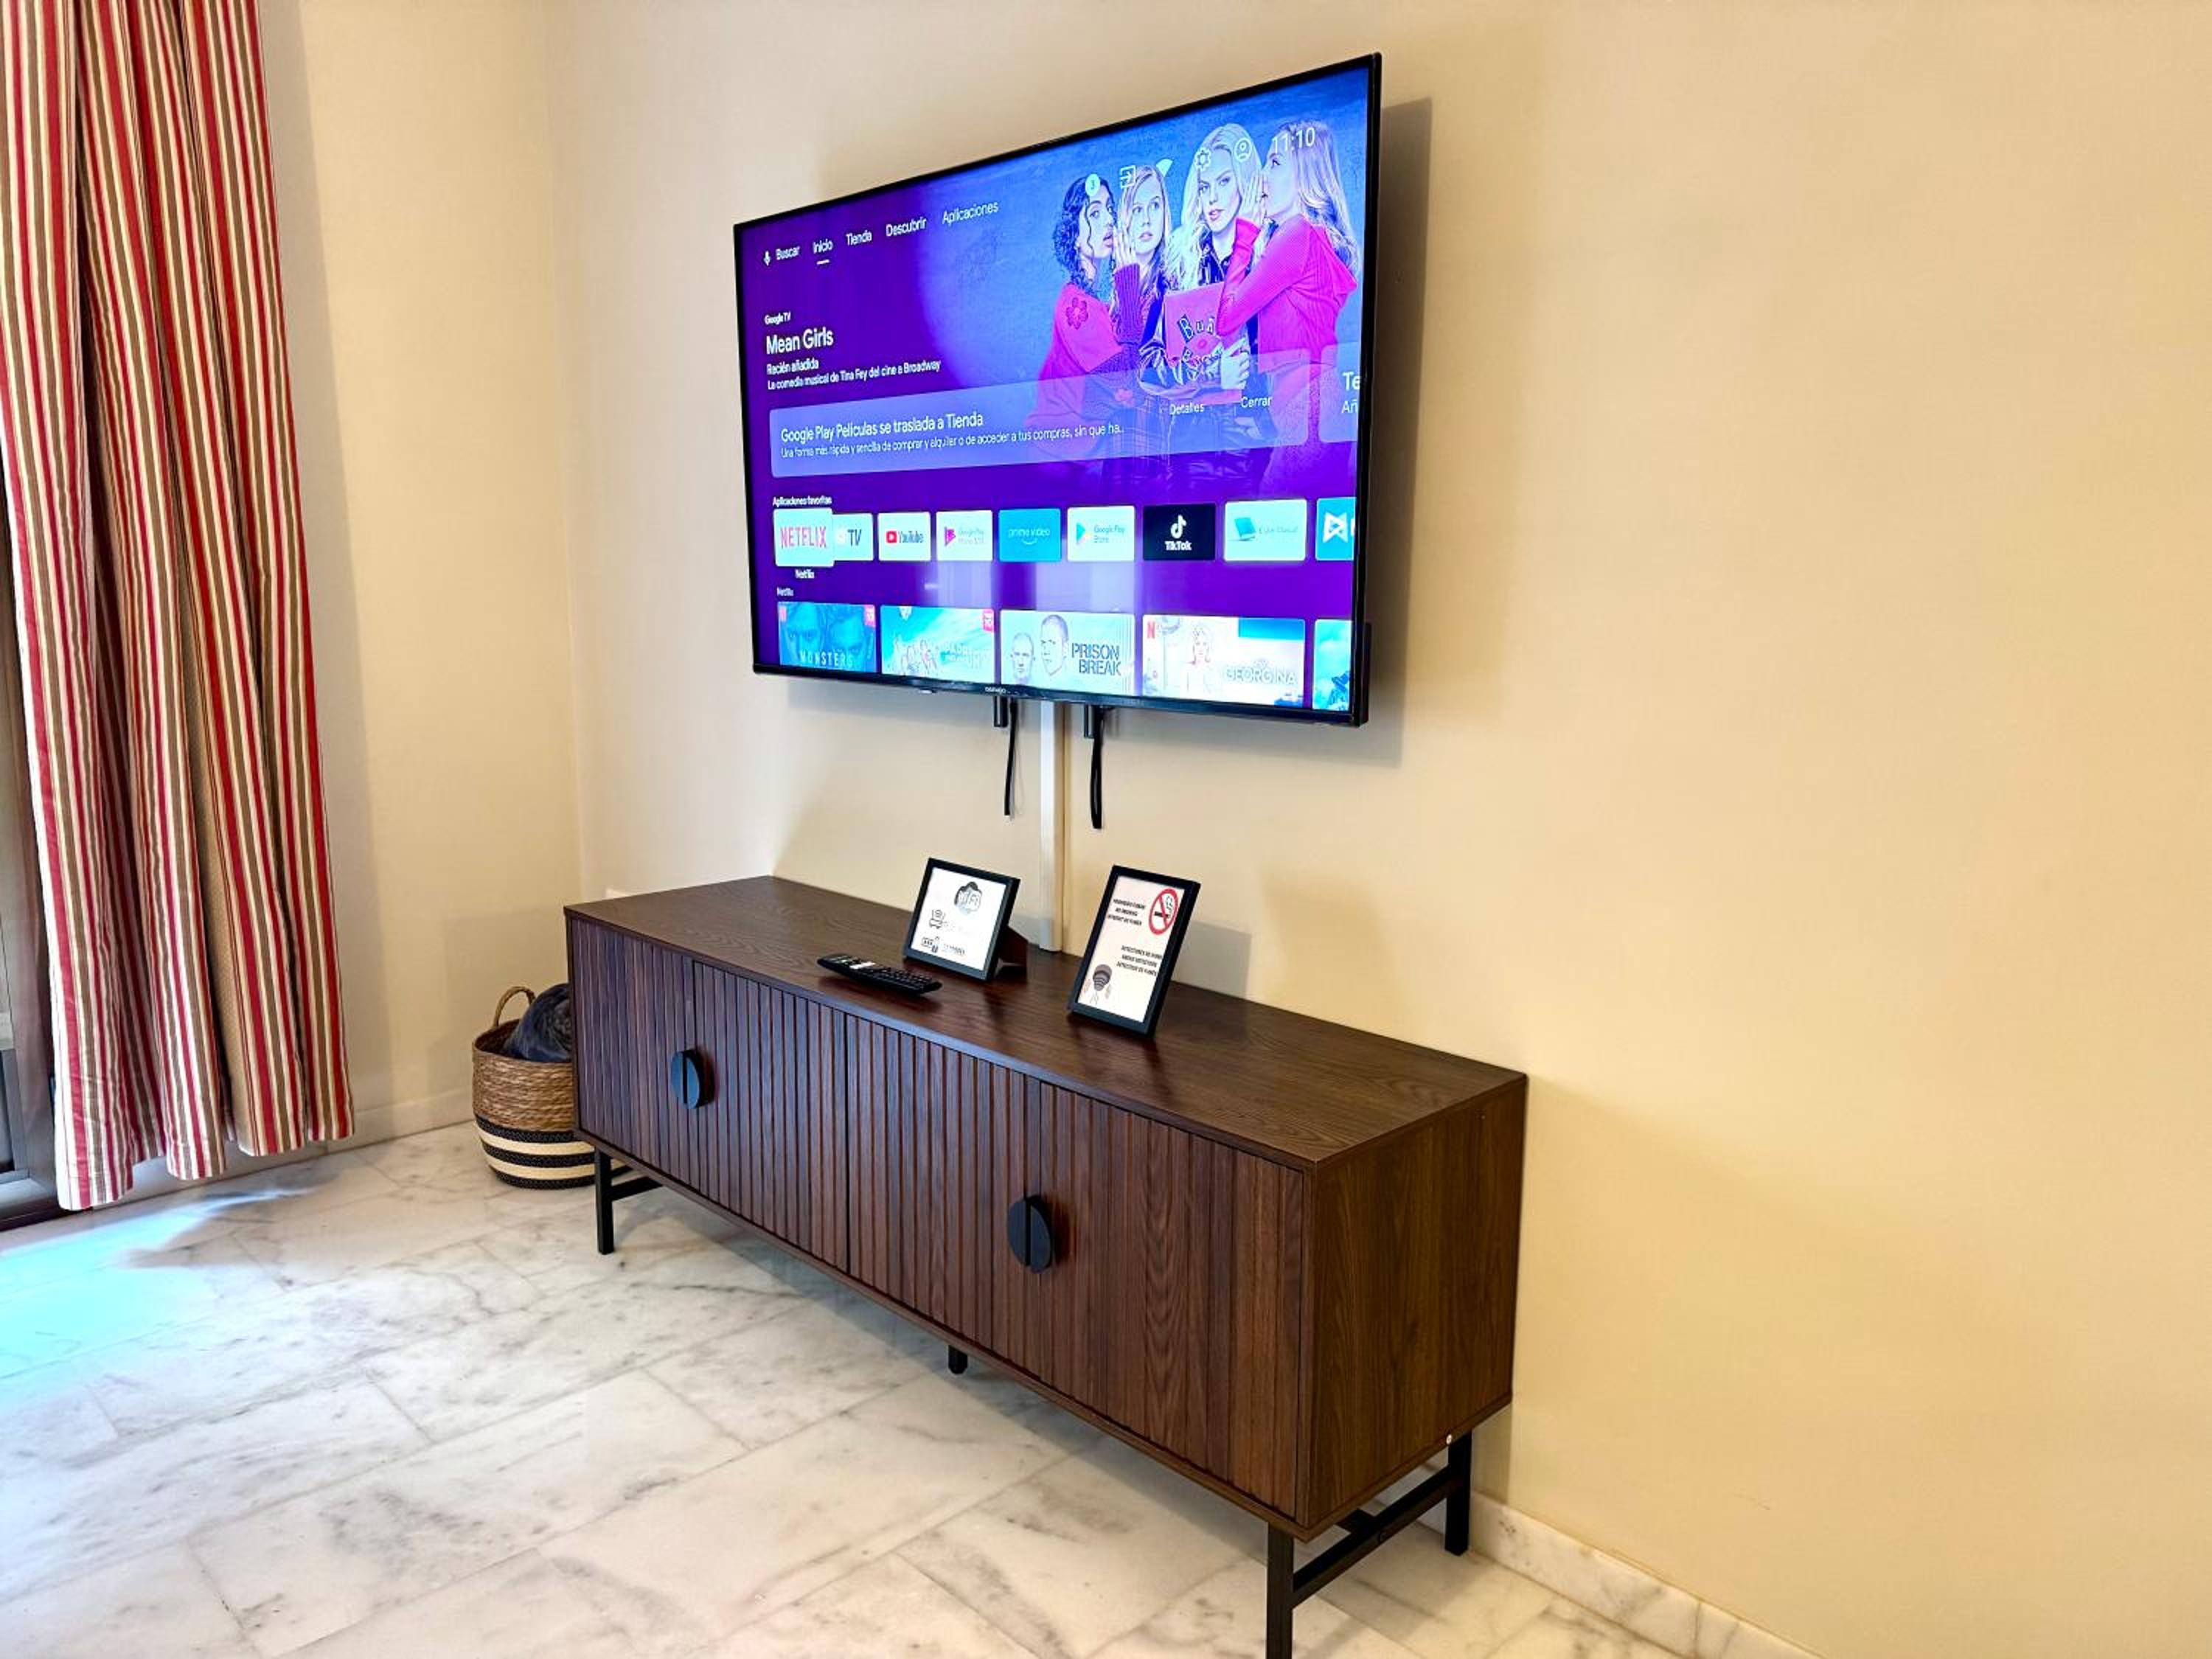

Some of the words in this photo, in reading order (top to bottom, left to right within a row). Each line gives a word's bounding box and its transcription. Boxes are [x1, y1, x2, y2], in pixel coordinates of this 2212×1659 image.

[1272, 127, 1315, 154] 11:10
[776, 246, 800, 260] Buscar
[813, 238, 834, 254] Inicio
[846, 229, 872, 246] Tienda
[886, 216, 927, 237] Descubrir
[942, 201, 999, 226] Aplicaciones
[765, 313, 783, 325] Google
[766, 334, 800, 355] Mean
[803, 327, 834, 349] Girls
[768, 380, 776, 390] La
[804, 373, 830, 386] musical
[830, 372, 839, 382] de
[840, 369, 854, 381] Tina
[855, 368, 867, 381] Fey
[869, 366, 880, 378] del
[881, 365, 897, 377] cine
[898, 366, 903, 375] a
[904, 360, 941, 374] Broadway
[1169, 403, 1205, 416] Detalles
[1241, 396, 1272, 408] Cerrar
[782, 426, 814, 445] Google
[815, 425, 835, 442] Play
[880, 422, 891, 434] se
[894, 415, 936, 433] traslada
[938, 417, 944, 430] a
[945, 411, 984, 428] Tienda
[882, 440, 891, 451] de
[892, 439, 922, 452] comprar
[925, 439, 929, 450] y
[966, 434, 975, 445] de
[978, 432, 1009, 445] acceder
[1011, 433, 1016, 442] a
[1018, 430, 1032, 441] tus
[1033, 428, 1073, 442] compras,
[1074, 425, 1086, 437] sin
[1089, 424, 1105, 439] que
[780, 526, 827, 549] NETFLIX
[847, 528, 862, 547] TV
[898, 529, 924, 543] YouTube
[1164, 540, 1192, 552] TikTok
[1071, 642, 1120, 661] PRISON
[1079, 658, 1121, 677] BREAK
